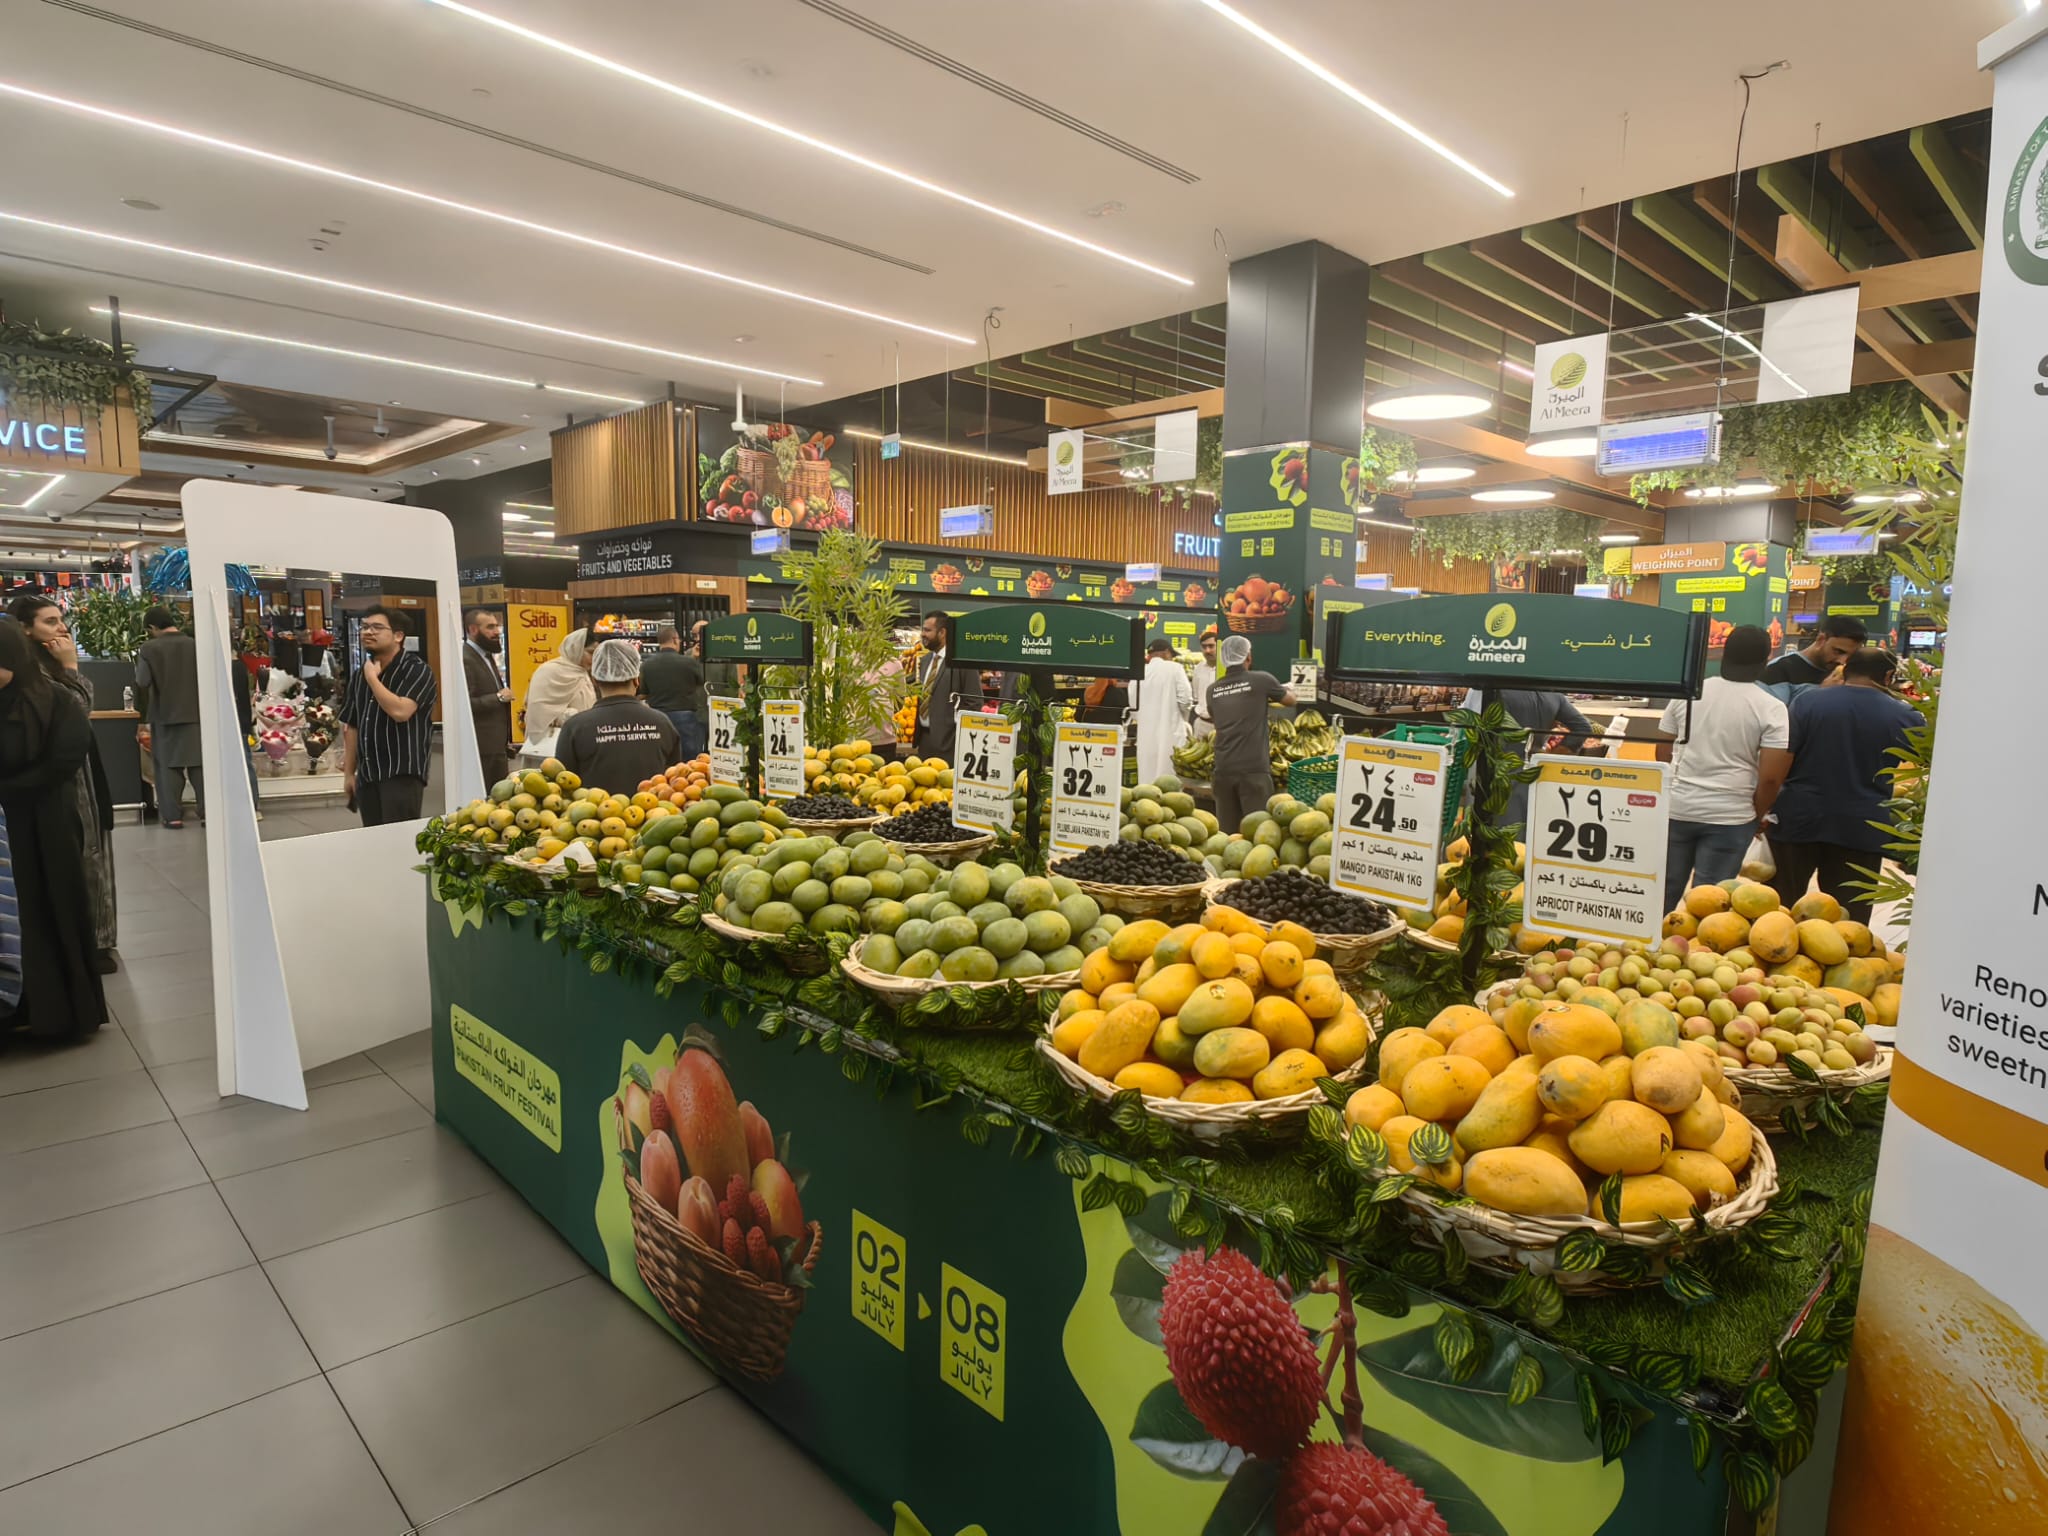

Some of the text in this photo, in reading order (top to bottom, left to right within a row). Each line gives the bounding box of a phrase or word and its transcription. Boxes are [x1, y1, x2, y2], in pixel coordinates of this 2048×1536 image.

[581, 554, 672, 577] FRUITS AND VEGETABLES
[1633, 557, 1720, 571] WEIGHING POINT
[520, 609, 557, 628] Sadia
[1021, 635, 1052, 647] الميرة
[1365, 630, 1446, 646] Everything.
[1470, 634, 1527, 652] الميرة
[1620, 634, 1652, 650] كل
[1021, 647, 1052, 655] almeera
[1468, 651, 1526, 663] almeera
[596, 735, 617, 743] HAPPY
[618, 734, 625, 742] TO
[627, 732, 647, 741] SERVE
[1360, 841, 1364, 852] 1
[1340, 859, 1422, 887] MANGO PAKISTAN 1KG
[1538, 872, 1645, 895] مشمش باكستان 1 كجم
[1536, 895, 1644, 924] APRICOT PAKISTAN 1KG
[494, 1047, 526, 1080] الفواكه
[456, 1045, 557, 1137] PAKISTAN FRUIT FESTIVAL
[527, 1068, 556, 1106] مهرجان
[857, 1230, 900, 1292] 02
[861, 1280, 895, 1316] يوليو
[861, 1301, 895, 1333] JULY
[946, 1286, 1000, 1353] 08
[951, 1341, 993, 1381] يوليو
[951, 1363, 993, 1401] JULY
